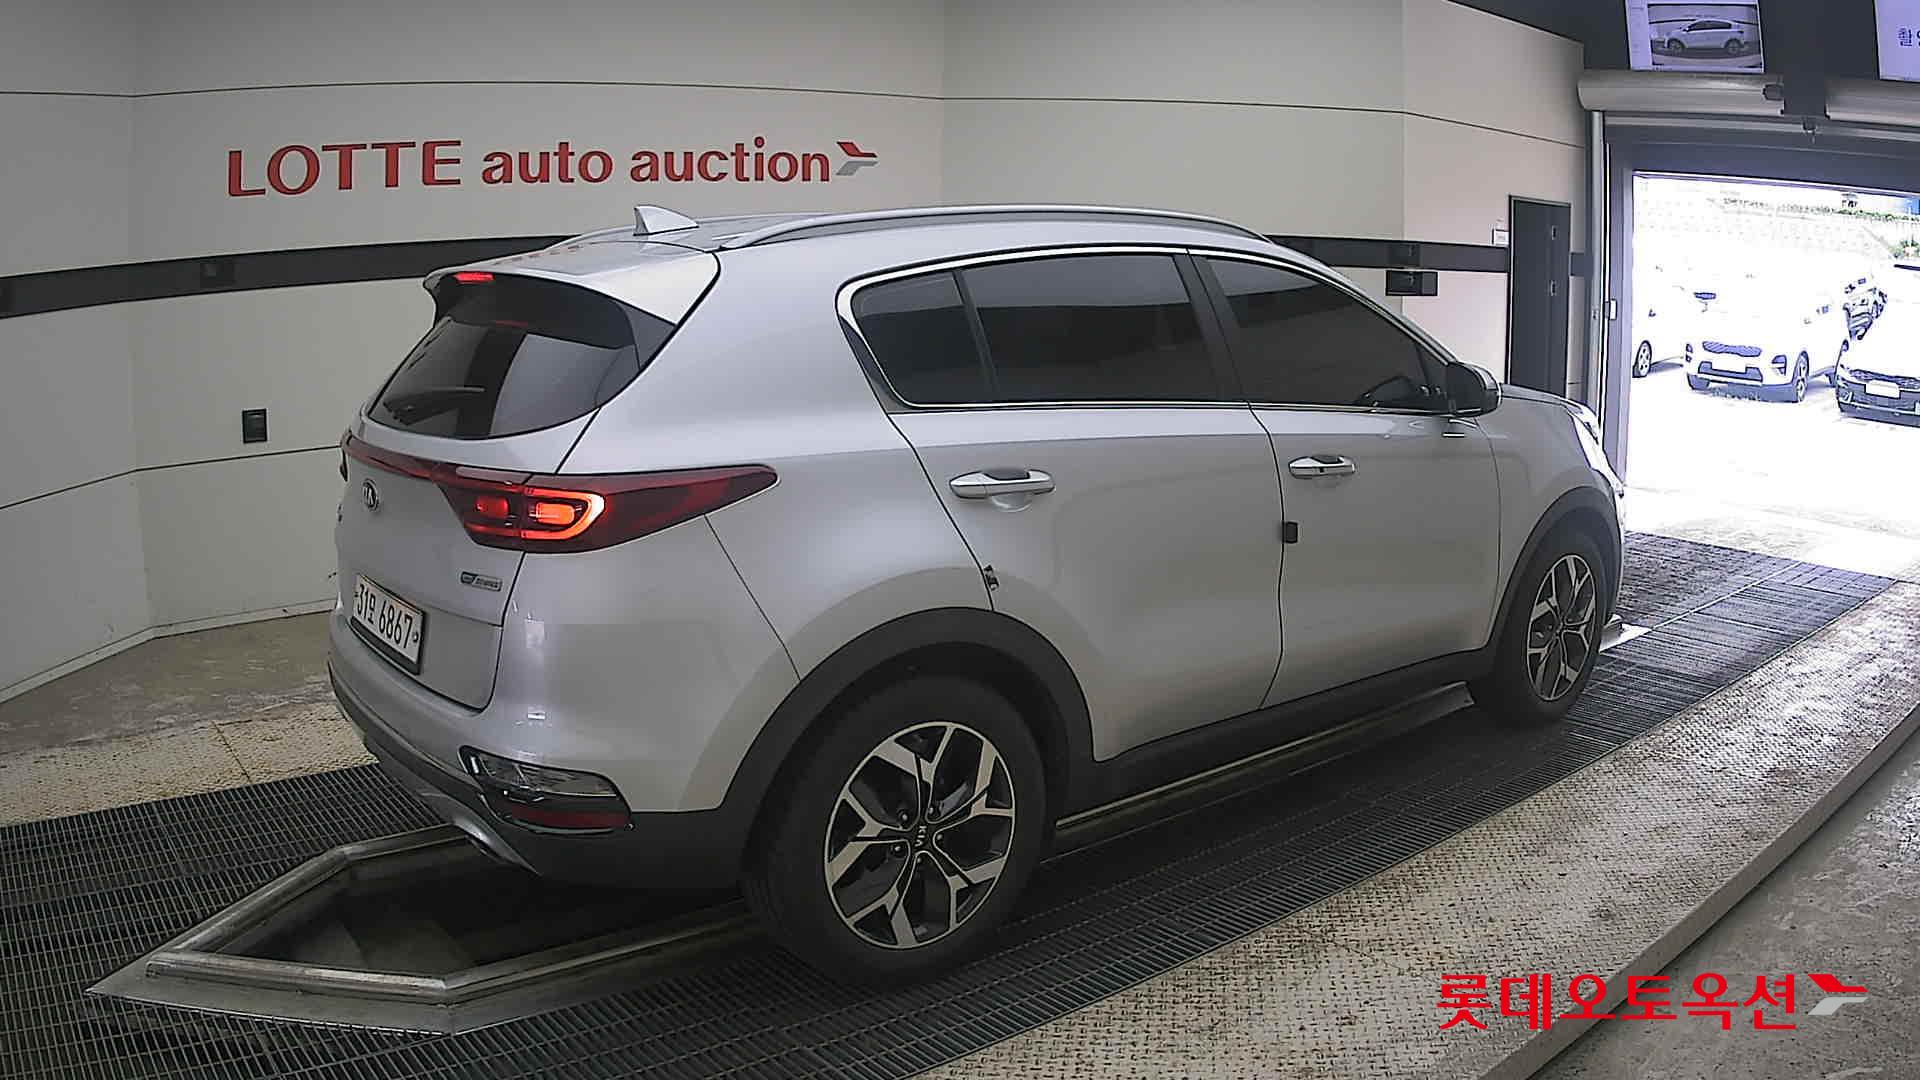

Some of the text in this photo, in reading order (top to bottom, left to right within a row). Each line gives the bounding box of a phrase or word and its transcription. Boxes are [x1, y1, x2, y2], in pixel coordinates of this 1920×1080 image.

[227, 136, 831, 197] LOTTE auto auction
[379, 600, 413, 648] 6867
